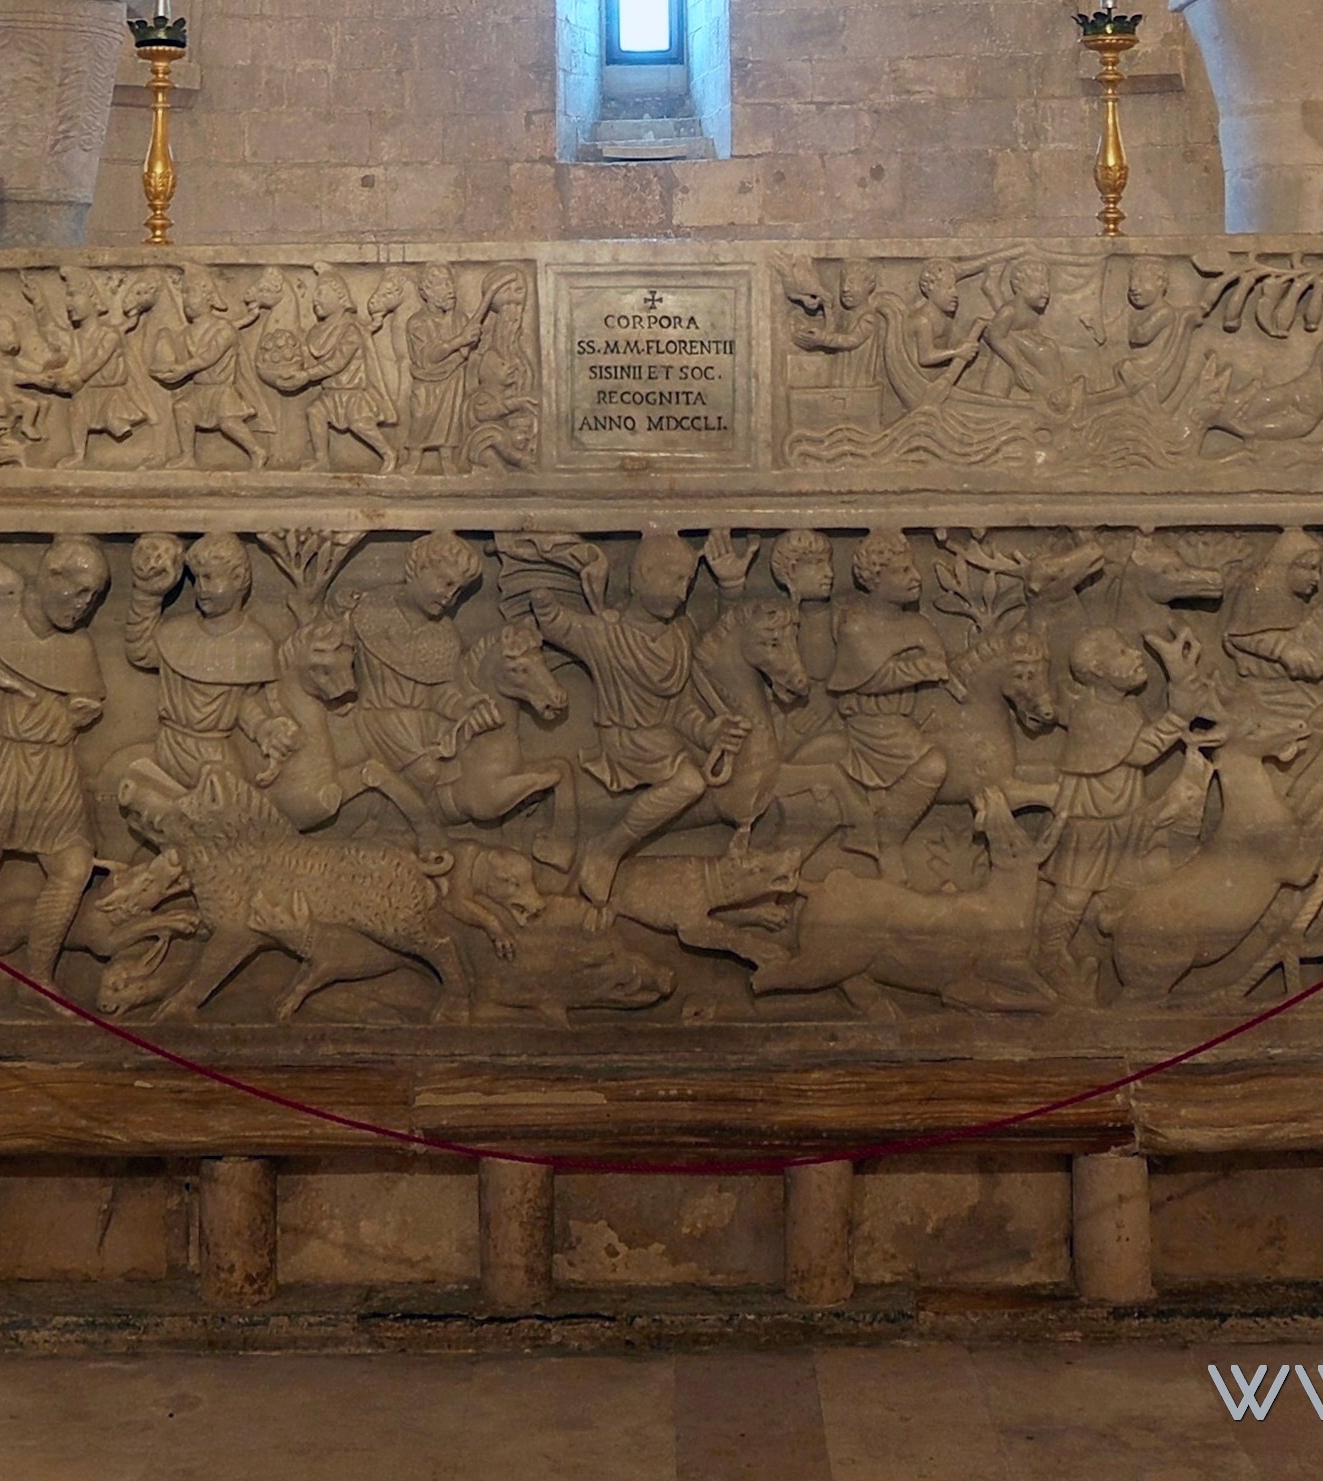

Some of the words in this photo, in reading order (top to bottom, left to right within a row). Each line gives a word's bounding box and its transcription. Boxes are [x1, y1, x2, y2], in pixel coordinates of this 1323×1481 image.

[604, 314, 700, 330] CORPORA
[589, 365, 642, 380] SISINII
[648, 365, 674, 380] ET
[679, 365, 723, 381] SOC.
[596, 390, 707, 406] RECOGNITA
[578, 416, 636, 431] ANNO
[646, 416, 728, 432] MDCCLI.
